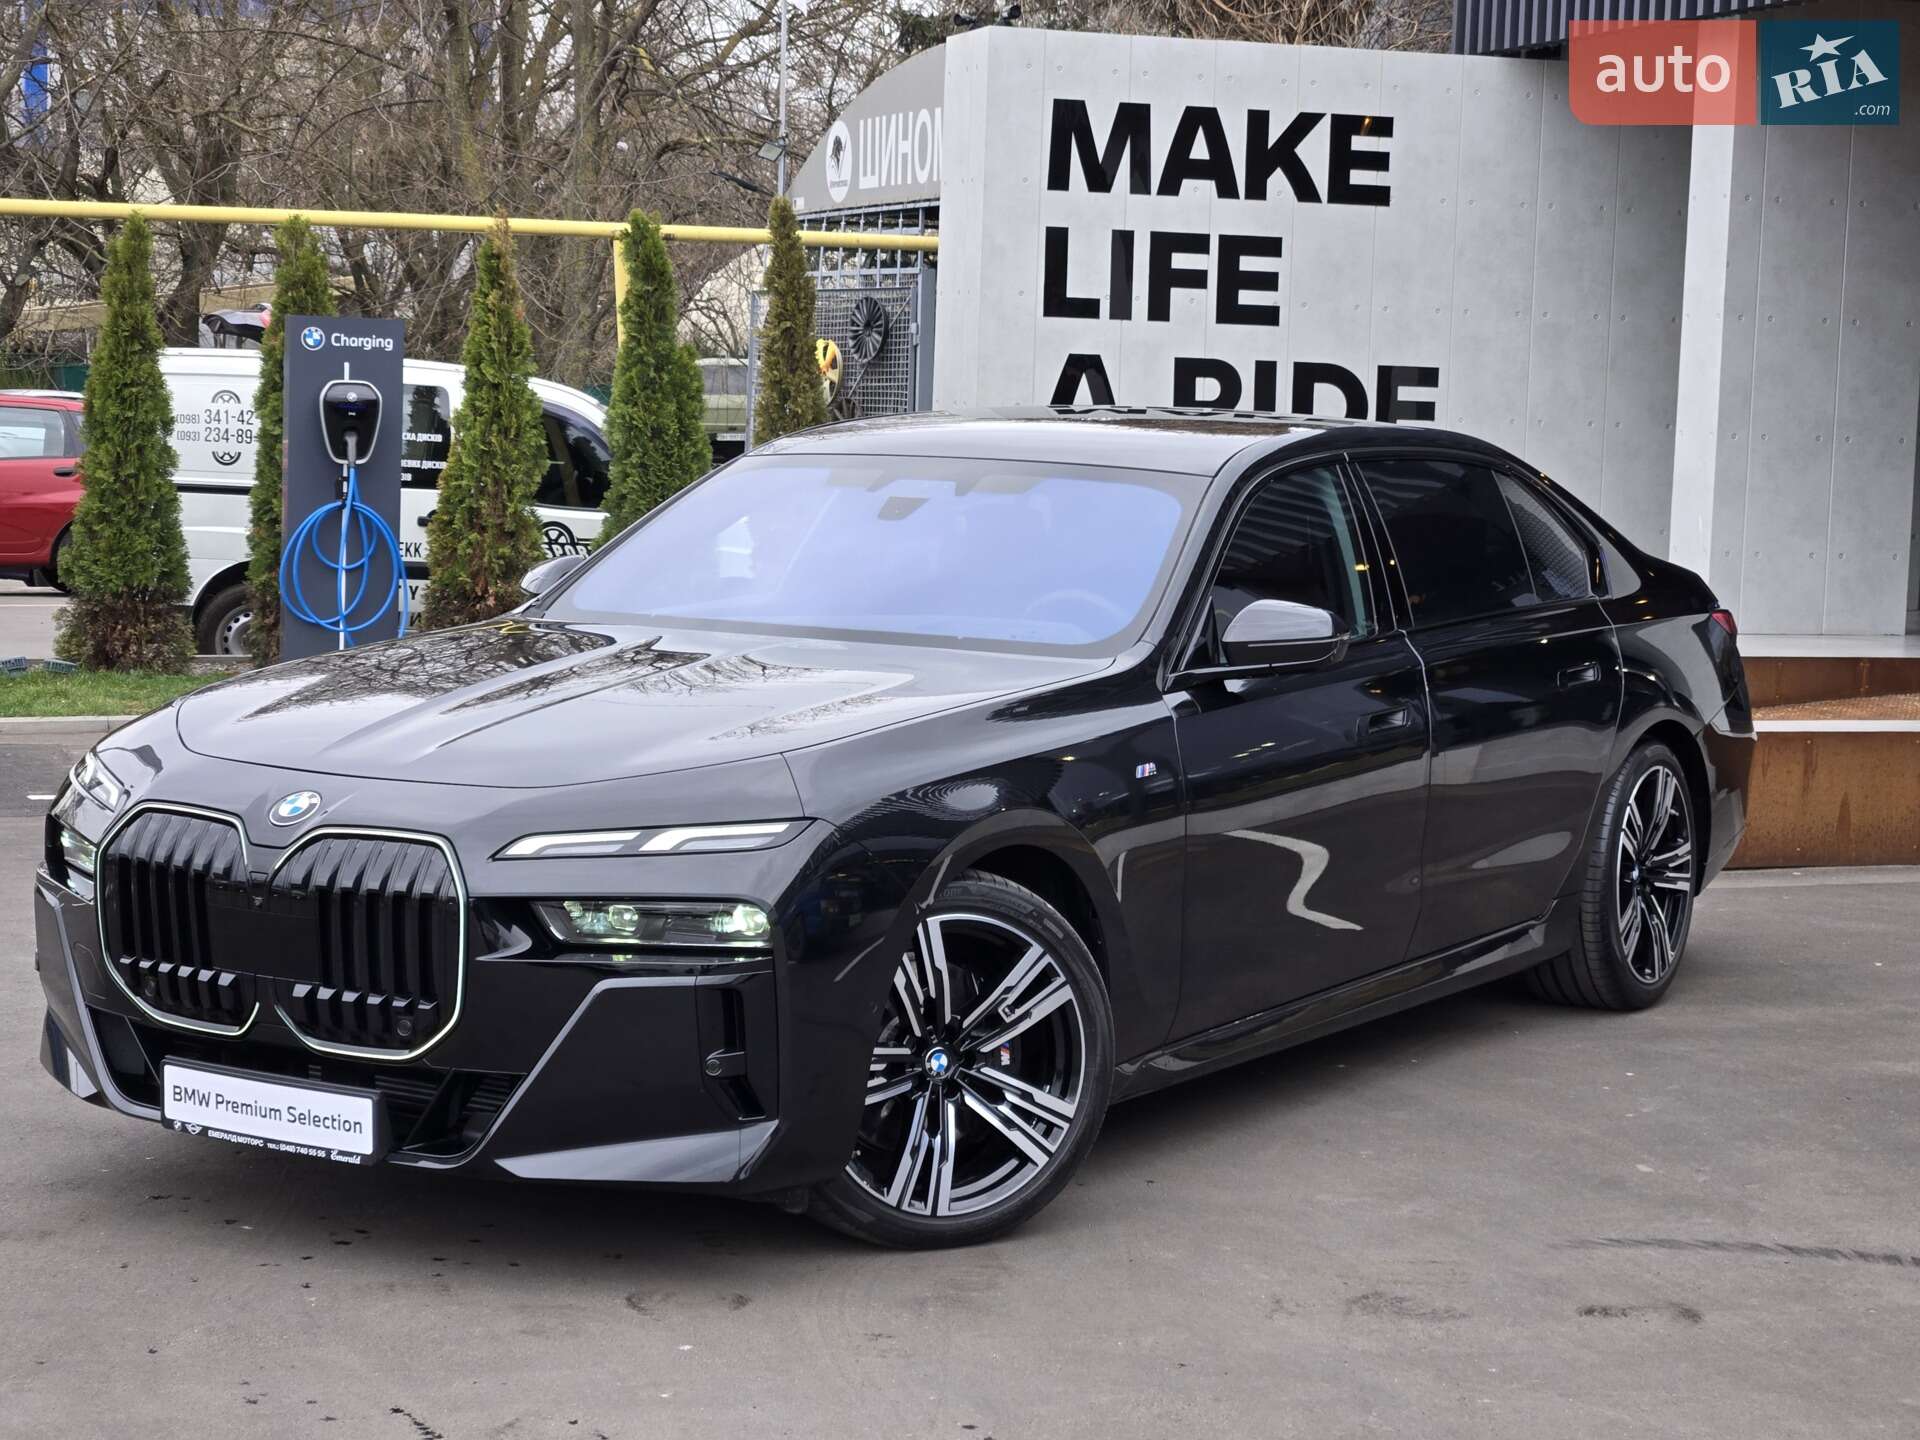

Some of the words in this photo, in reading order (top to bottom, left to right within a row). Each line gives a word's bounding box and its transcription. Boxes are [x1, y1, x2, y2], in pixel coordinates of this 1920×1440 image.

[1047, 98, 1394, 207] MAKE
[1043, 226, 1283, 327] LIFE
[331, 332, 394, 351] Charging
[173, 1085, 211, 1108] BMW
[215, 1093, 282, 1121] Premium
[287, 1106, 363, 1134] Selection
